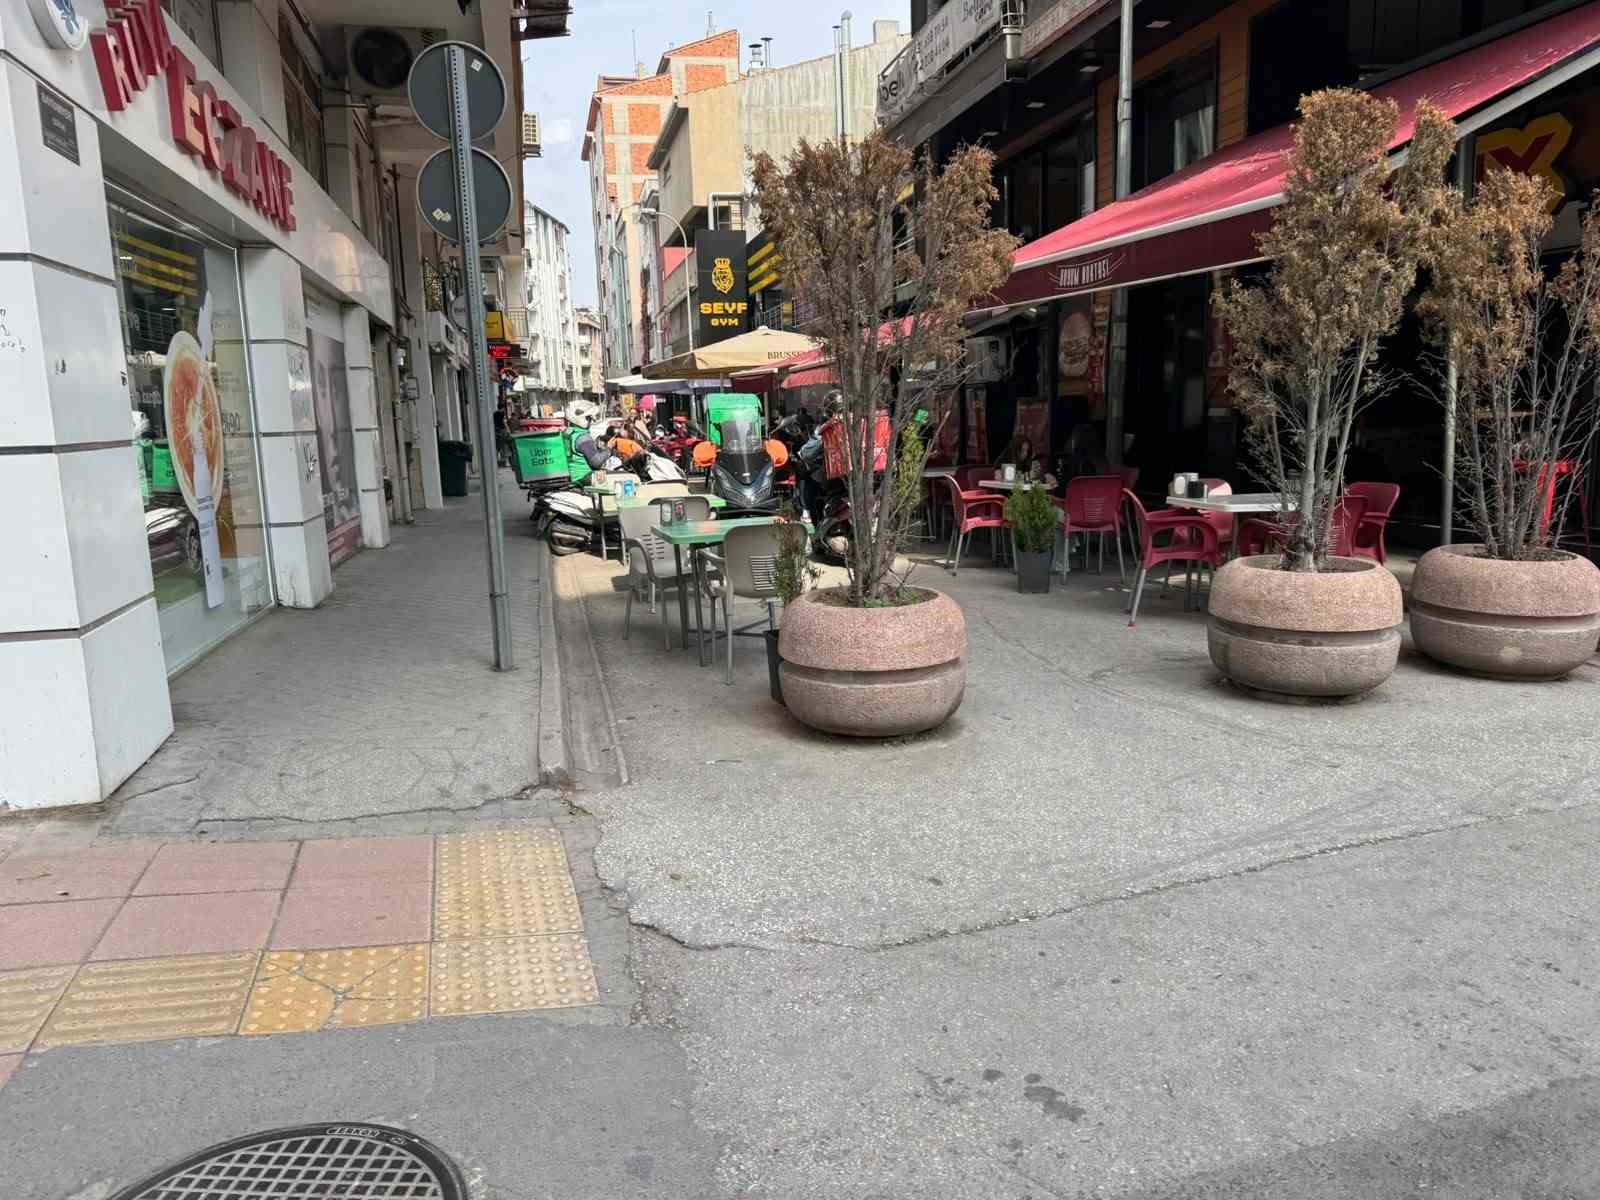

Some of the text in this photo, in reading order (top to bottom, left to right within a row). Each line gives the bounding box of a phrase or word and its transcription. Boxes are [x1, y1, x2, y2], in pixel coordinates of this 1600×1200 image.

[165, 45, 296, 232] ECZANE
[700, 302, 748, 314] SEYF
[711, 318, 739, 326] GYM
[529, 448, 552, 456] Uber
[531, 457, 555, 465] Eats
